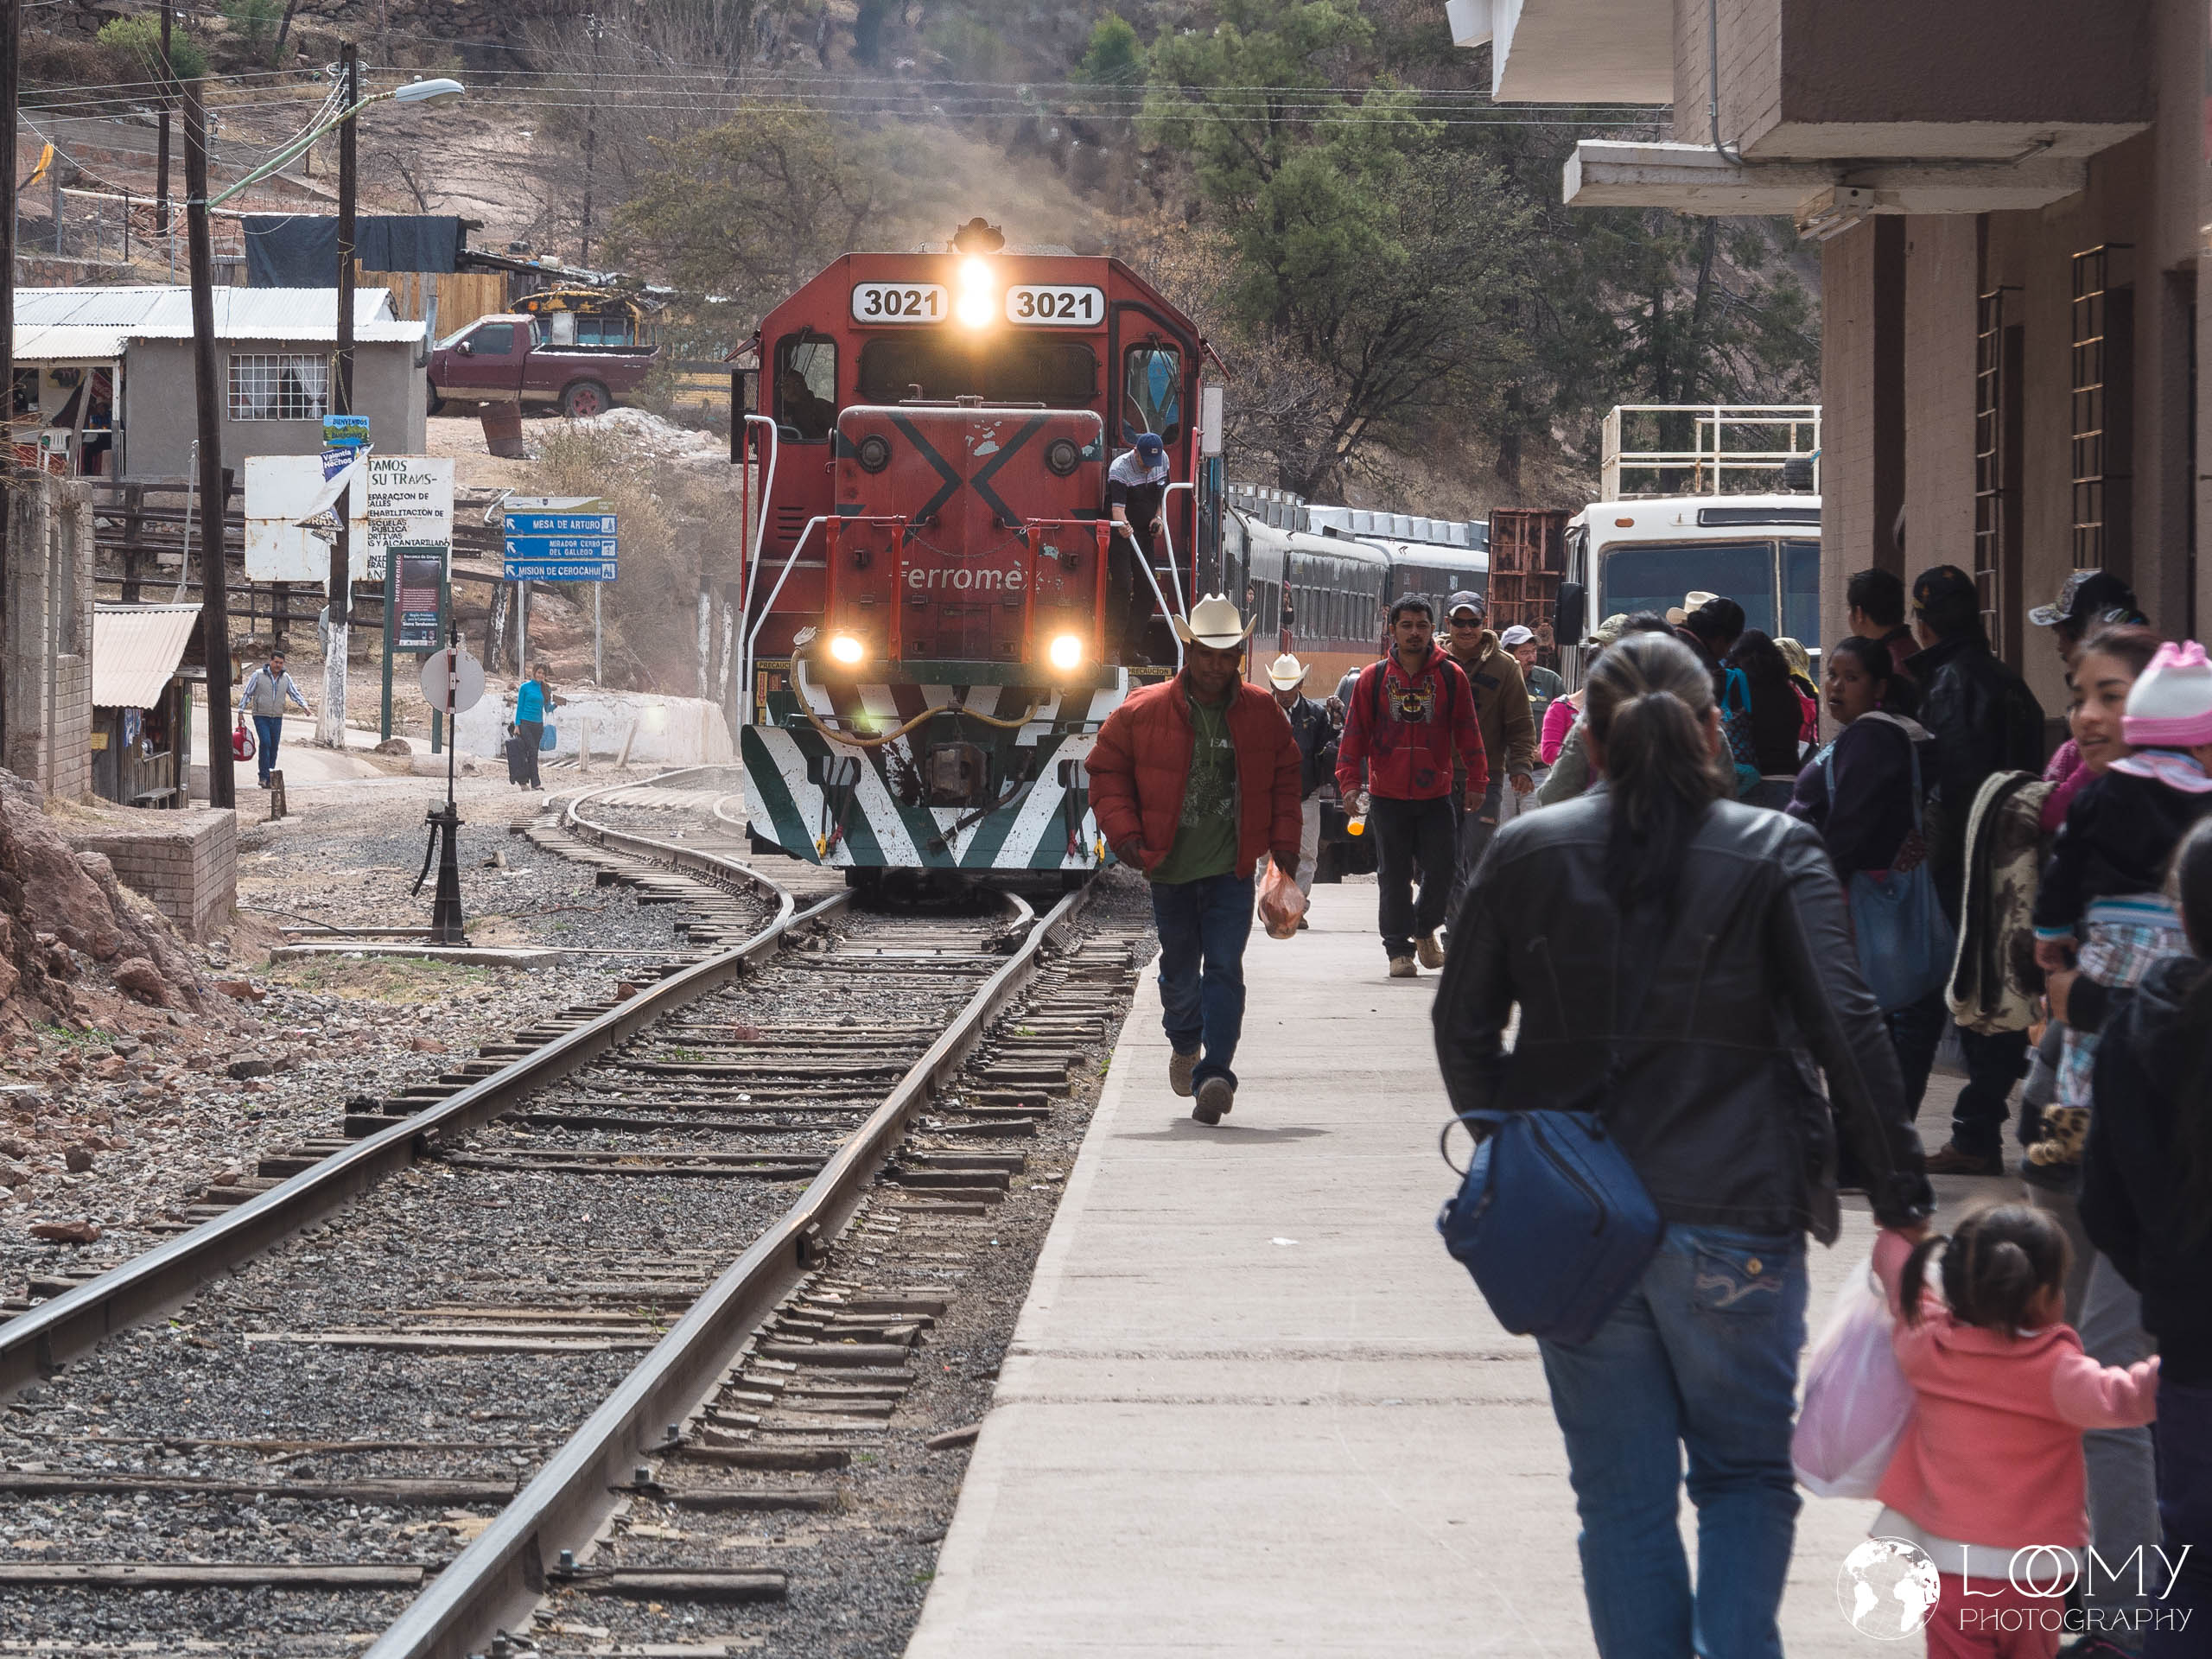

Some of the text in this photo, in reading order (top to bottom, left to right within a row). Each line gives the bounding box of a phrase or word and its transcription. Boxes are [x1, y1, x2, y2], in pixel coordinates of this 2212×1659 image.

[865, 290, 938, 315] 3021
[1017, 292, 1092, 318] 3021
[324, 458, 353, 469] Hechos
[372, 473, 388, 486] SU
[368, 518, 407, 527] ESCUELAS
[533, 519, 601, 530] MESA DE ARTURO
[546, 566, 557, 575] DE
[558, 566, 601, 575] CEROCAHUI
